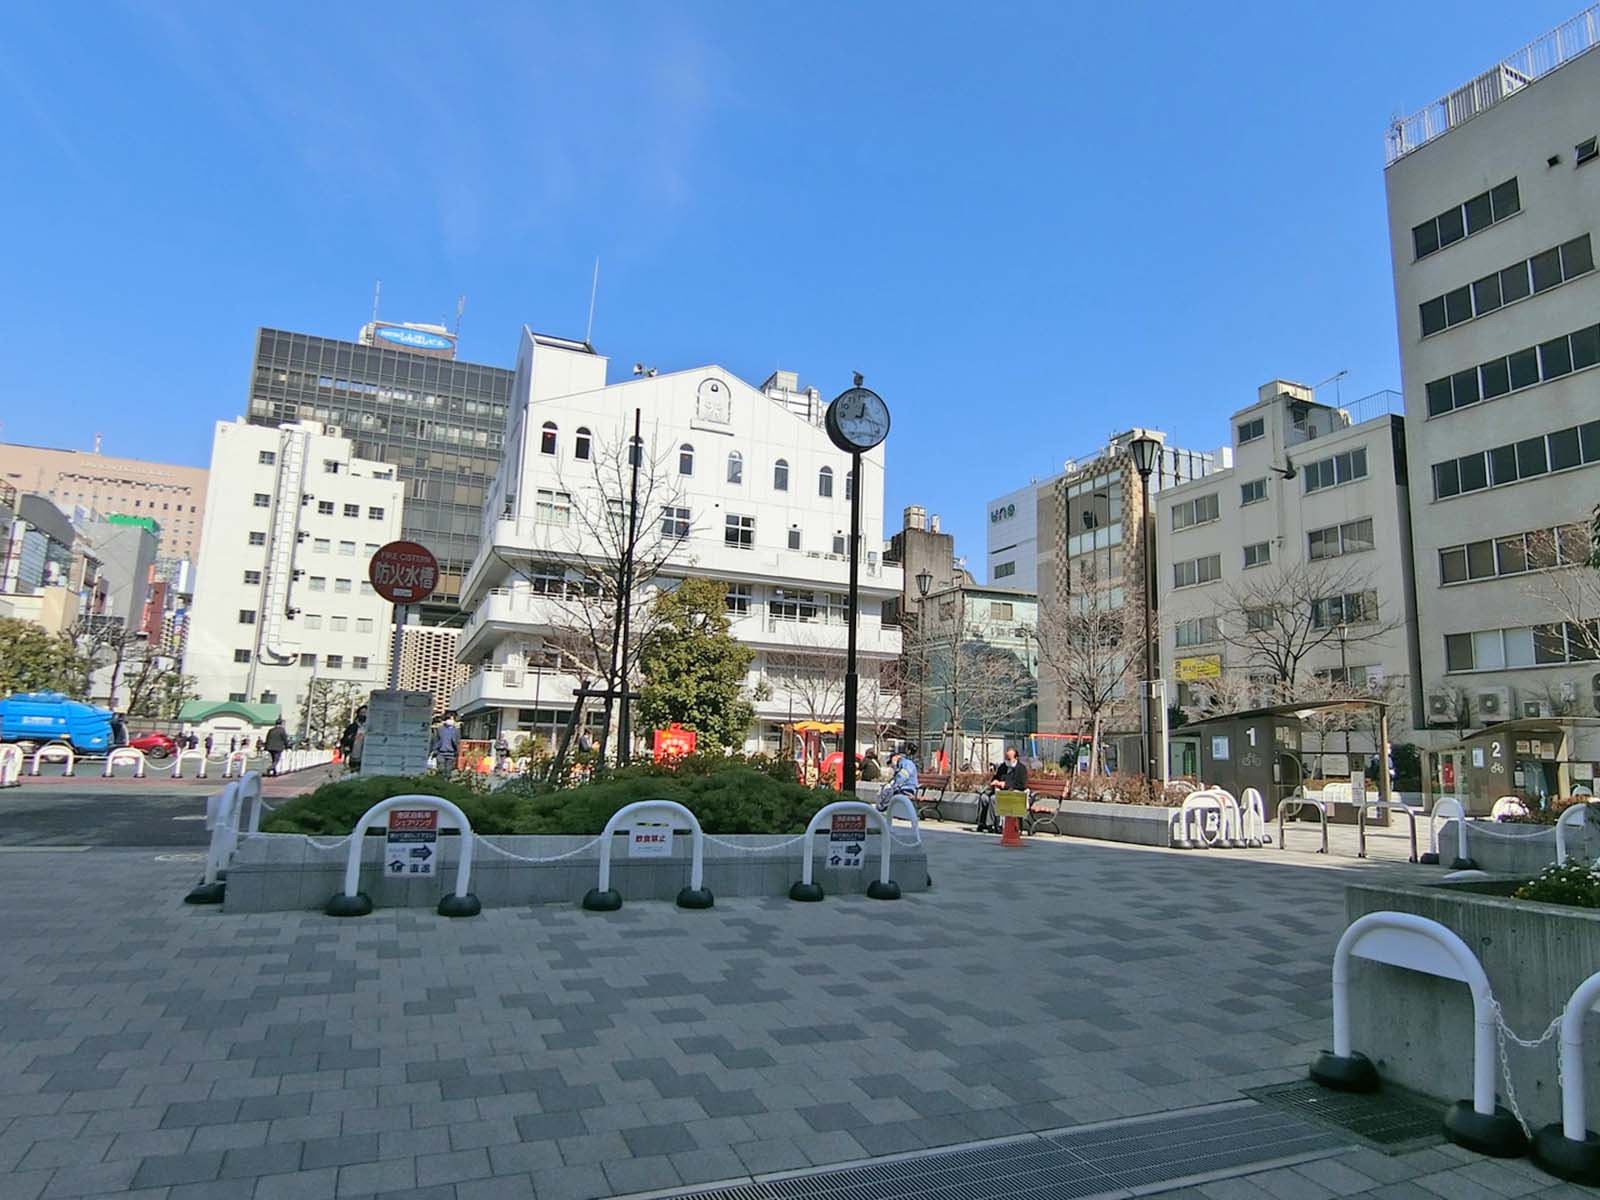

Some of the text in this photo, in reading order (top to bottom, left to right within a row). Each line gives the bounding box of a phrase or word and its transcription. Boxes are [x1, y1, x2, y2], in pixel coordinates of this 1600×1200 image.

[375, 560, 434, 589] 防火水槽
[1245, 727, 1256, 747] 1
[1491, 741, 1501, 758] 2
